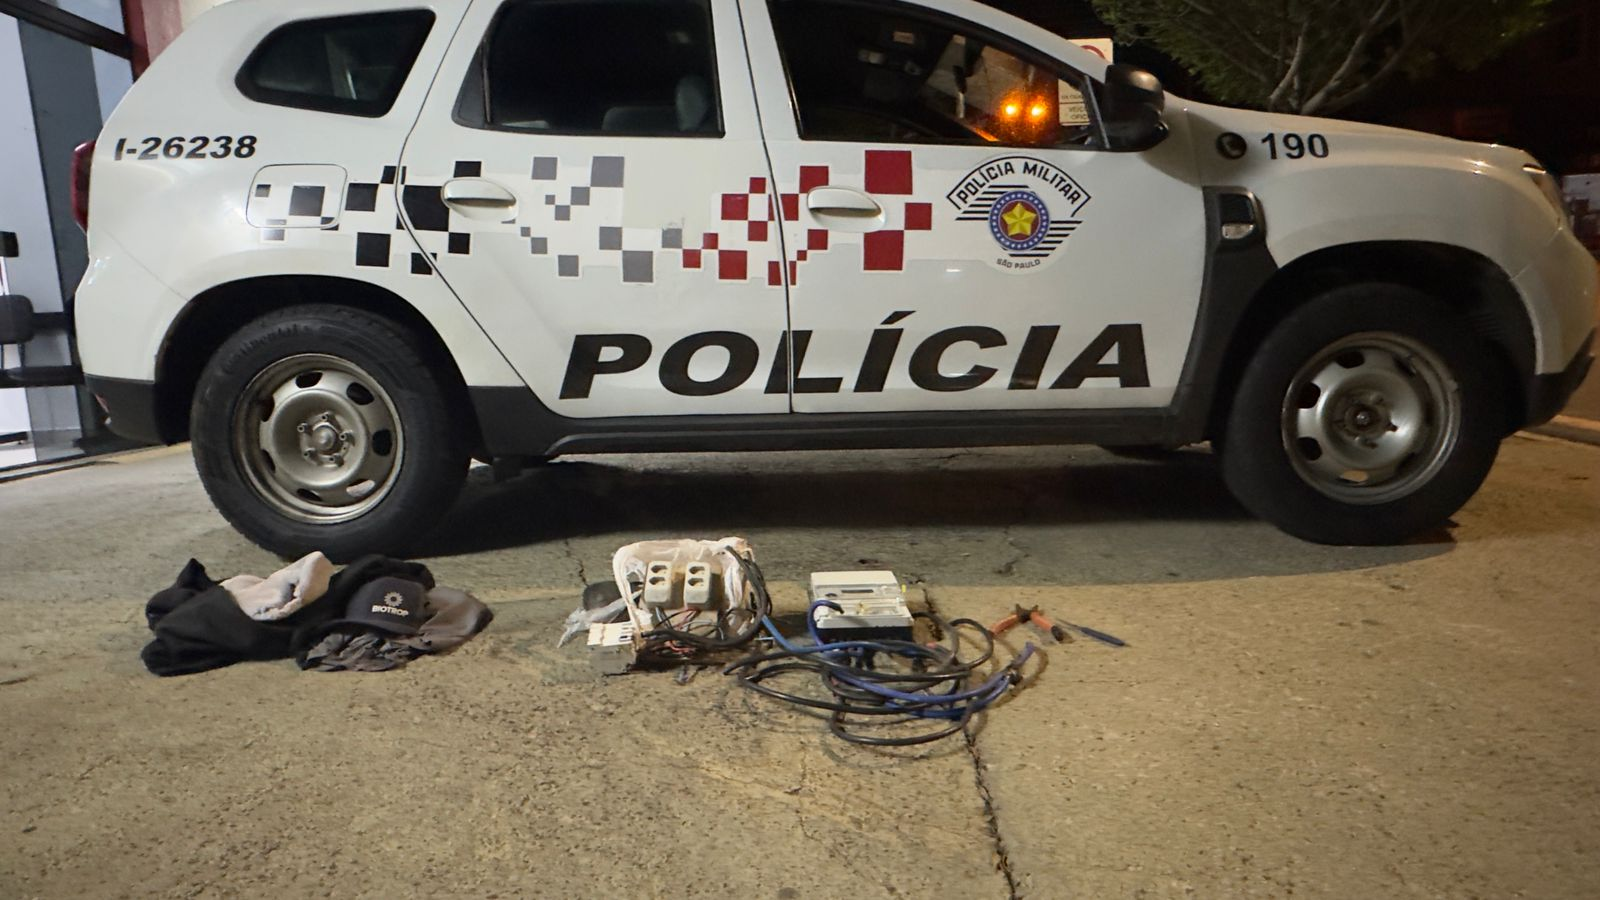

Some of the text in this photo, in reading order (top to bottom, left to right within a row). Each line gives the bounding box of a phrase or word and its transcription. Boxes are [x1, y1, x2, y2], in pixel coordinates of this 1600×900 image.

[114, 135, 258, 161] I-26238
[1260, 132, 1330, 160] 190
[956, 161, 1082, 205] POLÍCIA MILITAR
[996, 258, 1041, 269] SÃO PAULO
[559, 310, 1152, 400] POLÍCIA
[371, 604, 410, 617] BIOTROP
